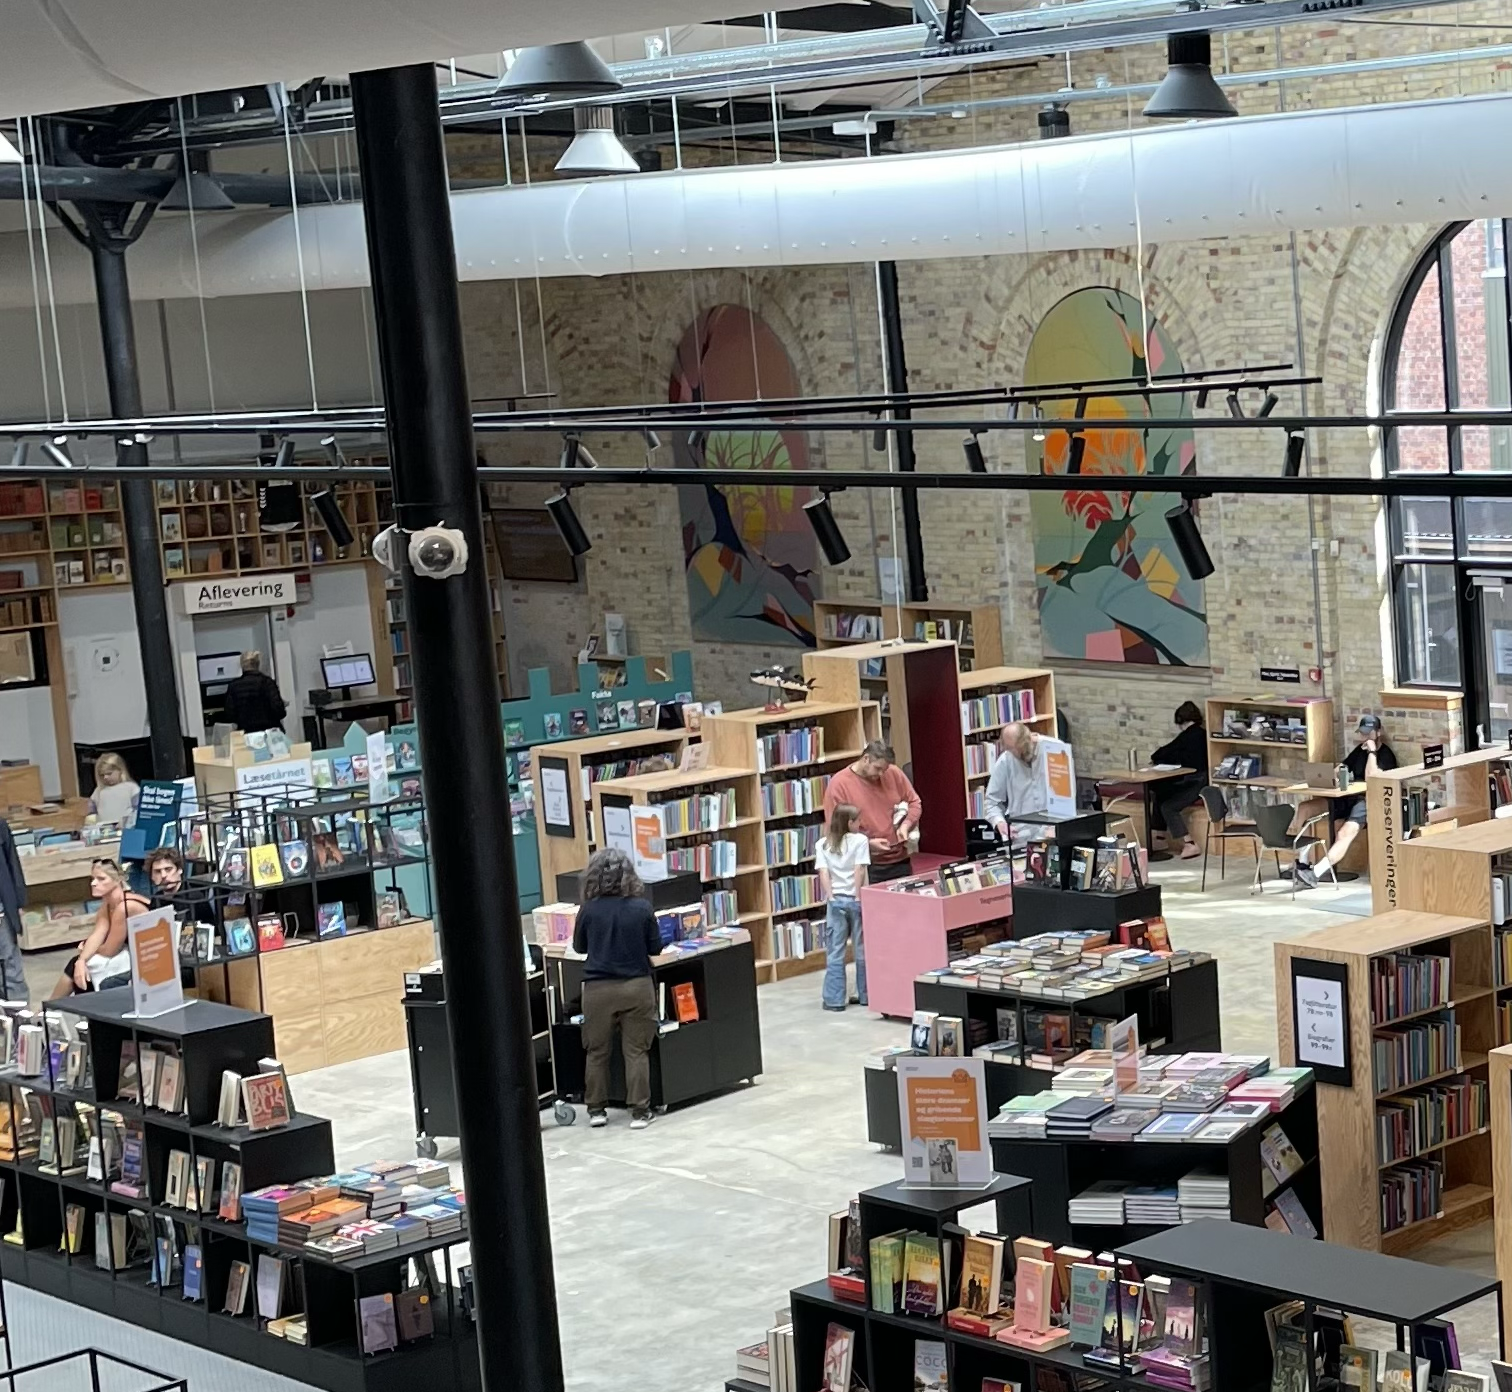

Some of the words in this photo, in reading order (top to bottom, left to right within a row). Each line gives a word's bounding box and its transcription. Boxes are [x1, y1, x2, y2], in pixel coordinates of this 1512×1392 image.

[198, 581, 284, 601] Aflevering
[243, 767, 306, 784] Læsetårnet
[1382, 786, 1398, 908] Reserveringer
[1386, 1369, 1412, 1389] KOL
